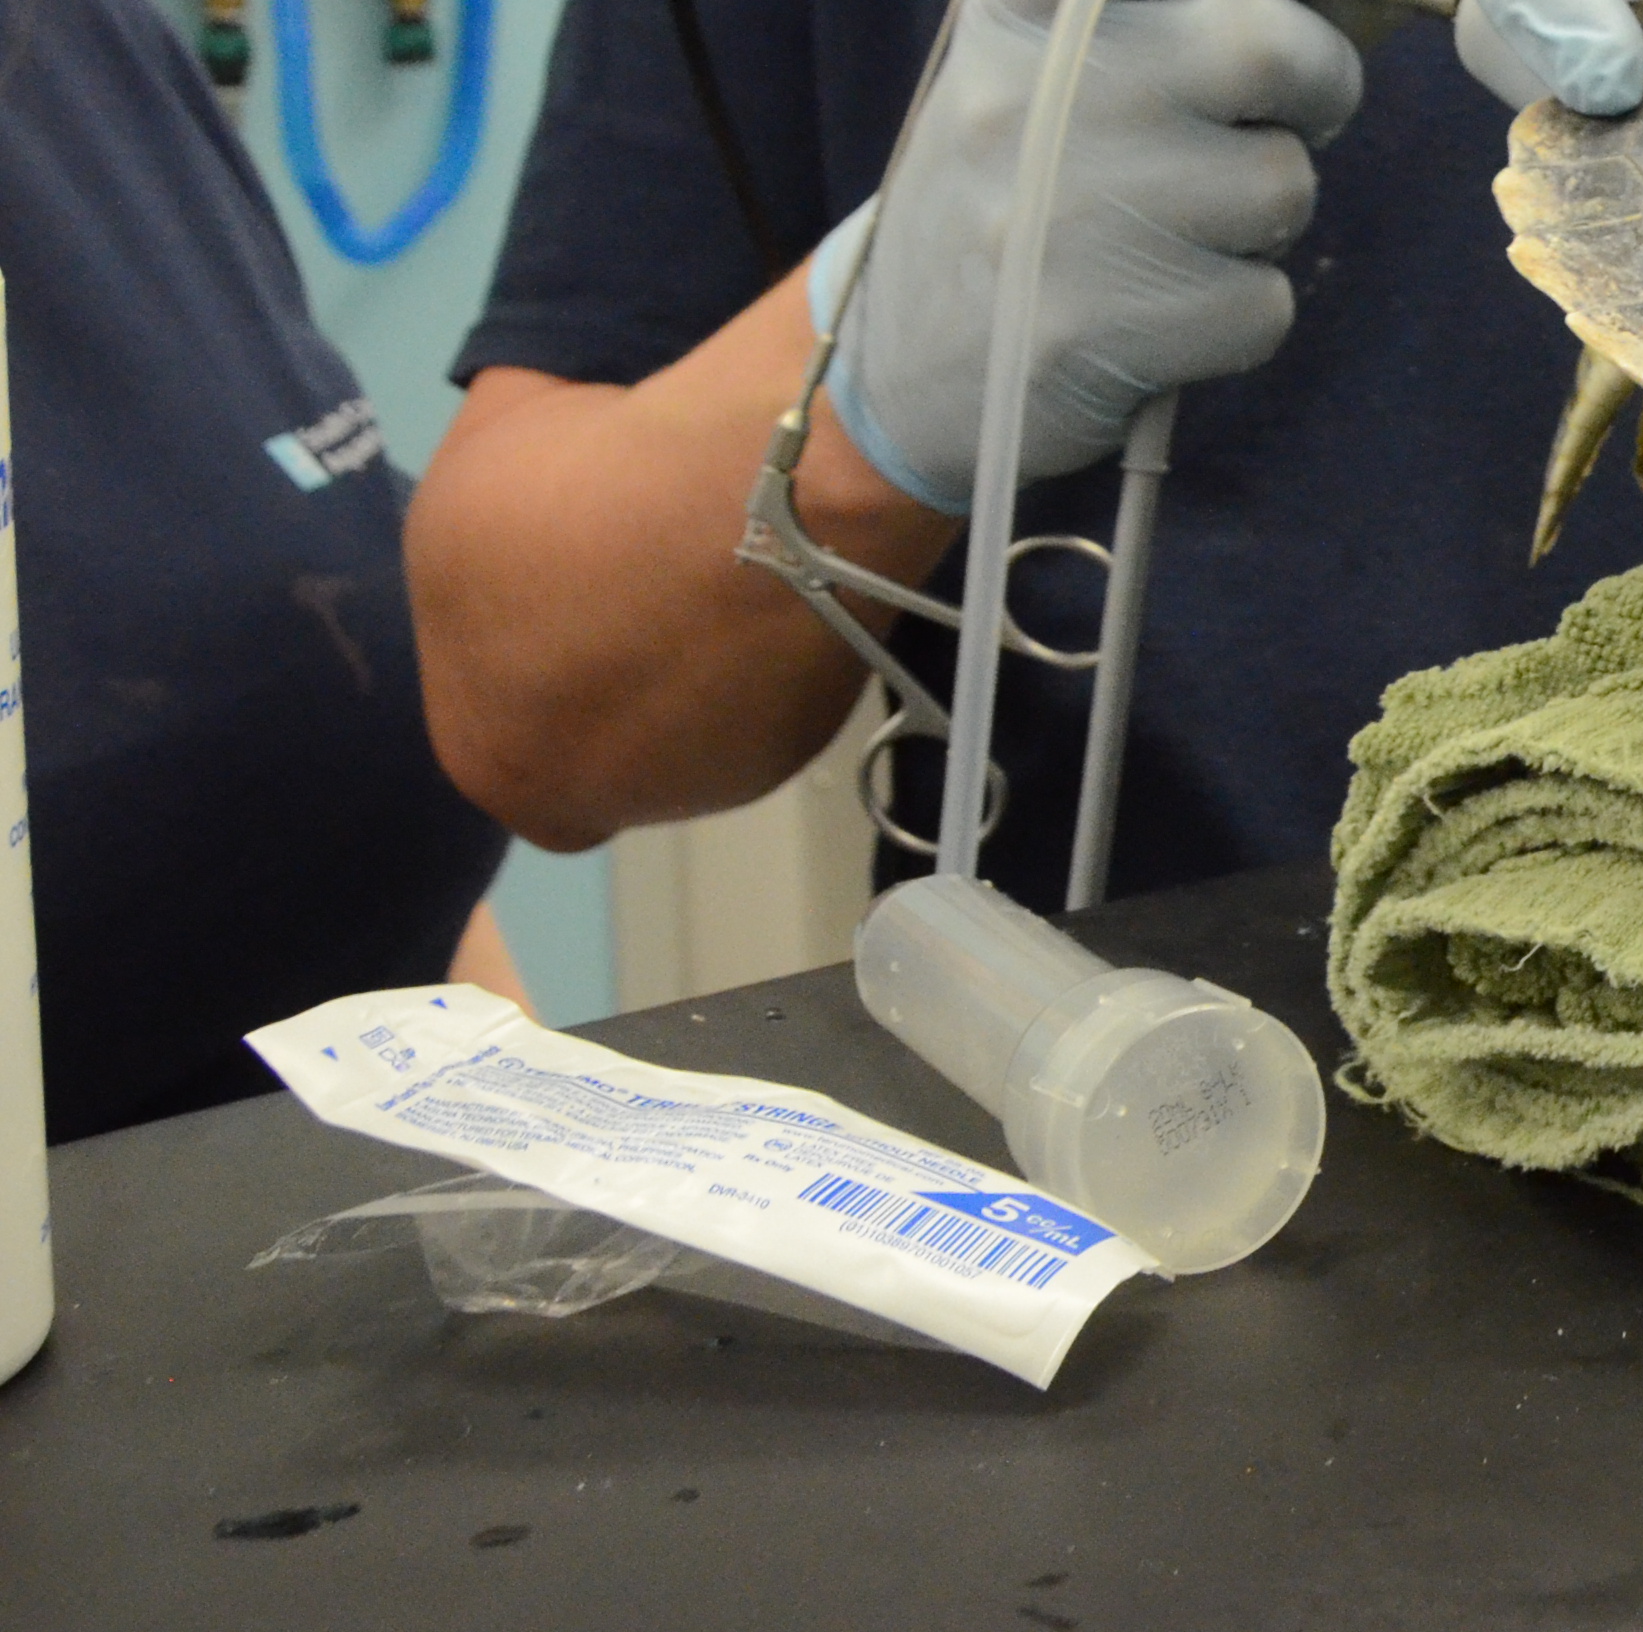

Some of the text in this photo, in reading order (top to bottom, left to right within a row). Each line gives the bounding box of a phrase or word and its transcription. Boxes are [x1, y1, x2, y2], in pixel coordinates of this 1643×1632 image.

[734, 1101, 842, 1130] SYRINGE
[918, 1156, 983, 1184] NEEDLE
[764, 1158, 793, 1173] Only
[980, 1196, 1082, 1249] 5 cc/mL
